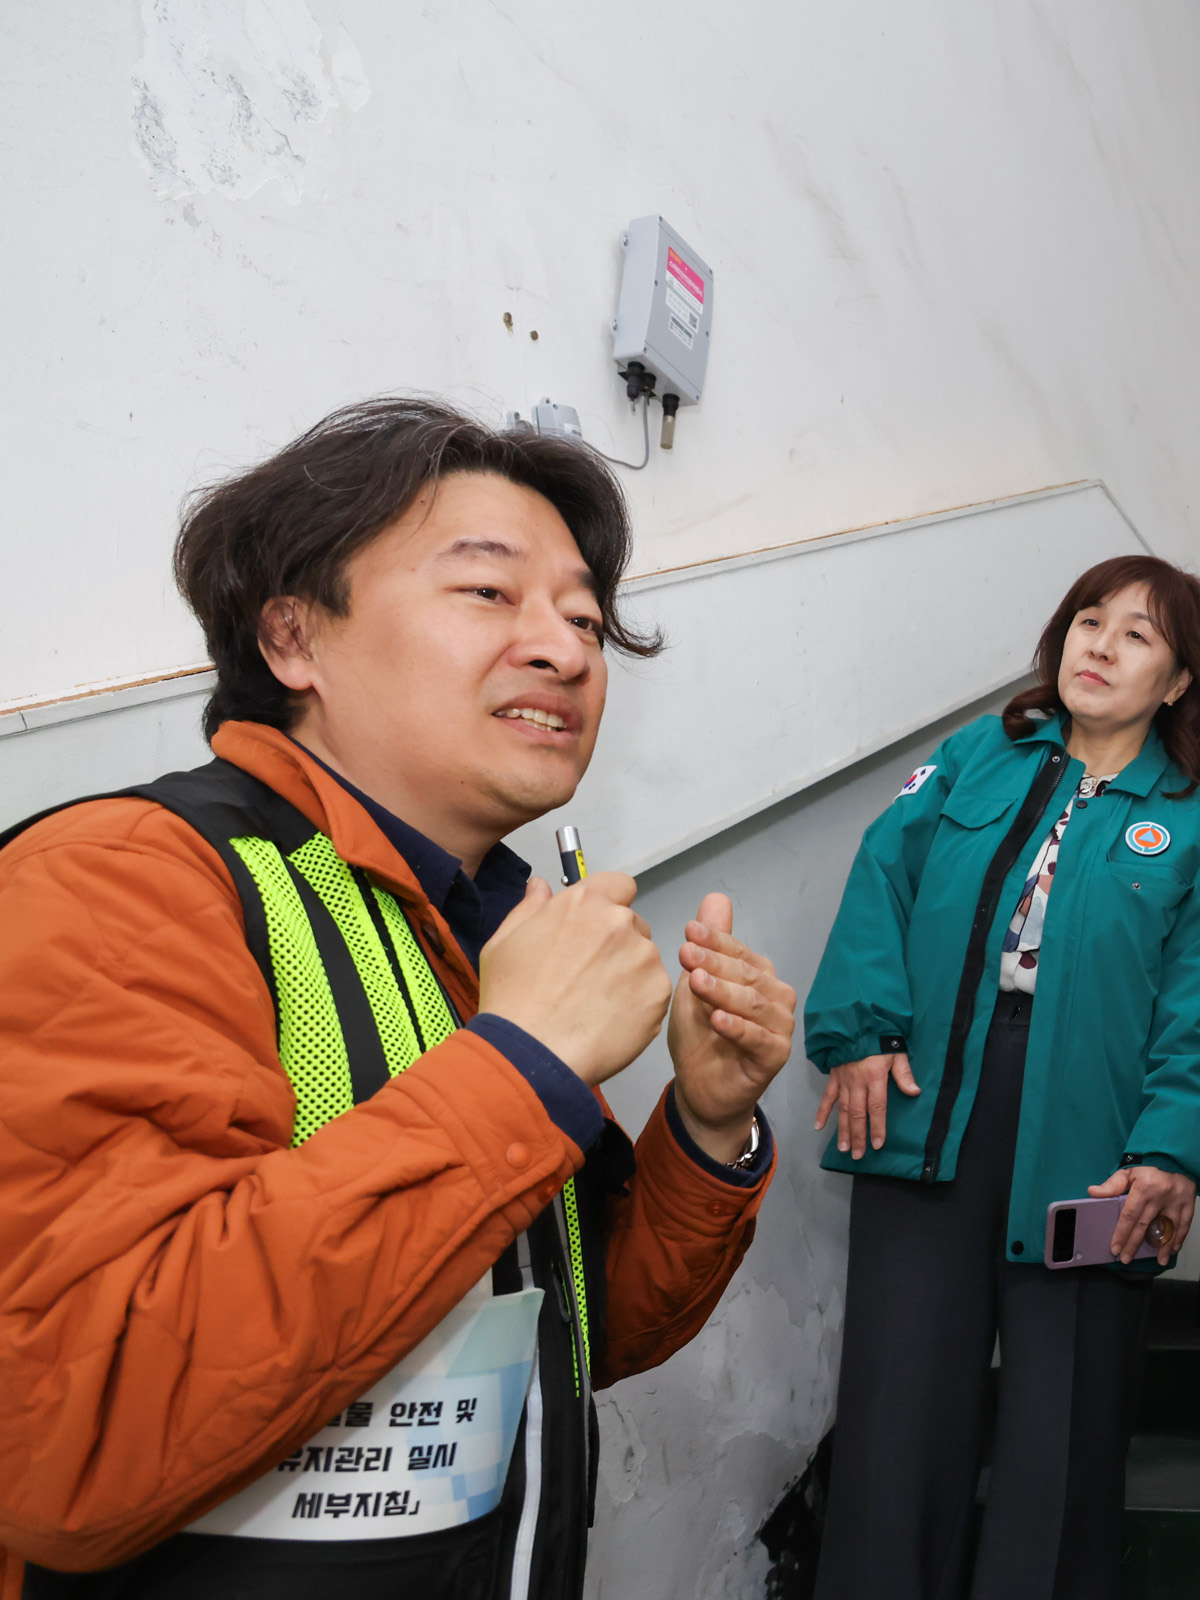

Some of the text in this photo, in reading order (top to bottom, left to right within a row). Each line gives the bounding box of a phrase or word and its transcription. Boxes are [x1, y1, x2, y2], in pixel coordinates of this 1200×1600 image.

[389, 1401, 443, 1427] 안전
[456, 1398, 478, 1424] 및
[408, 1442, 458, 1471] 실시
